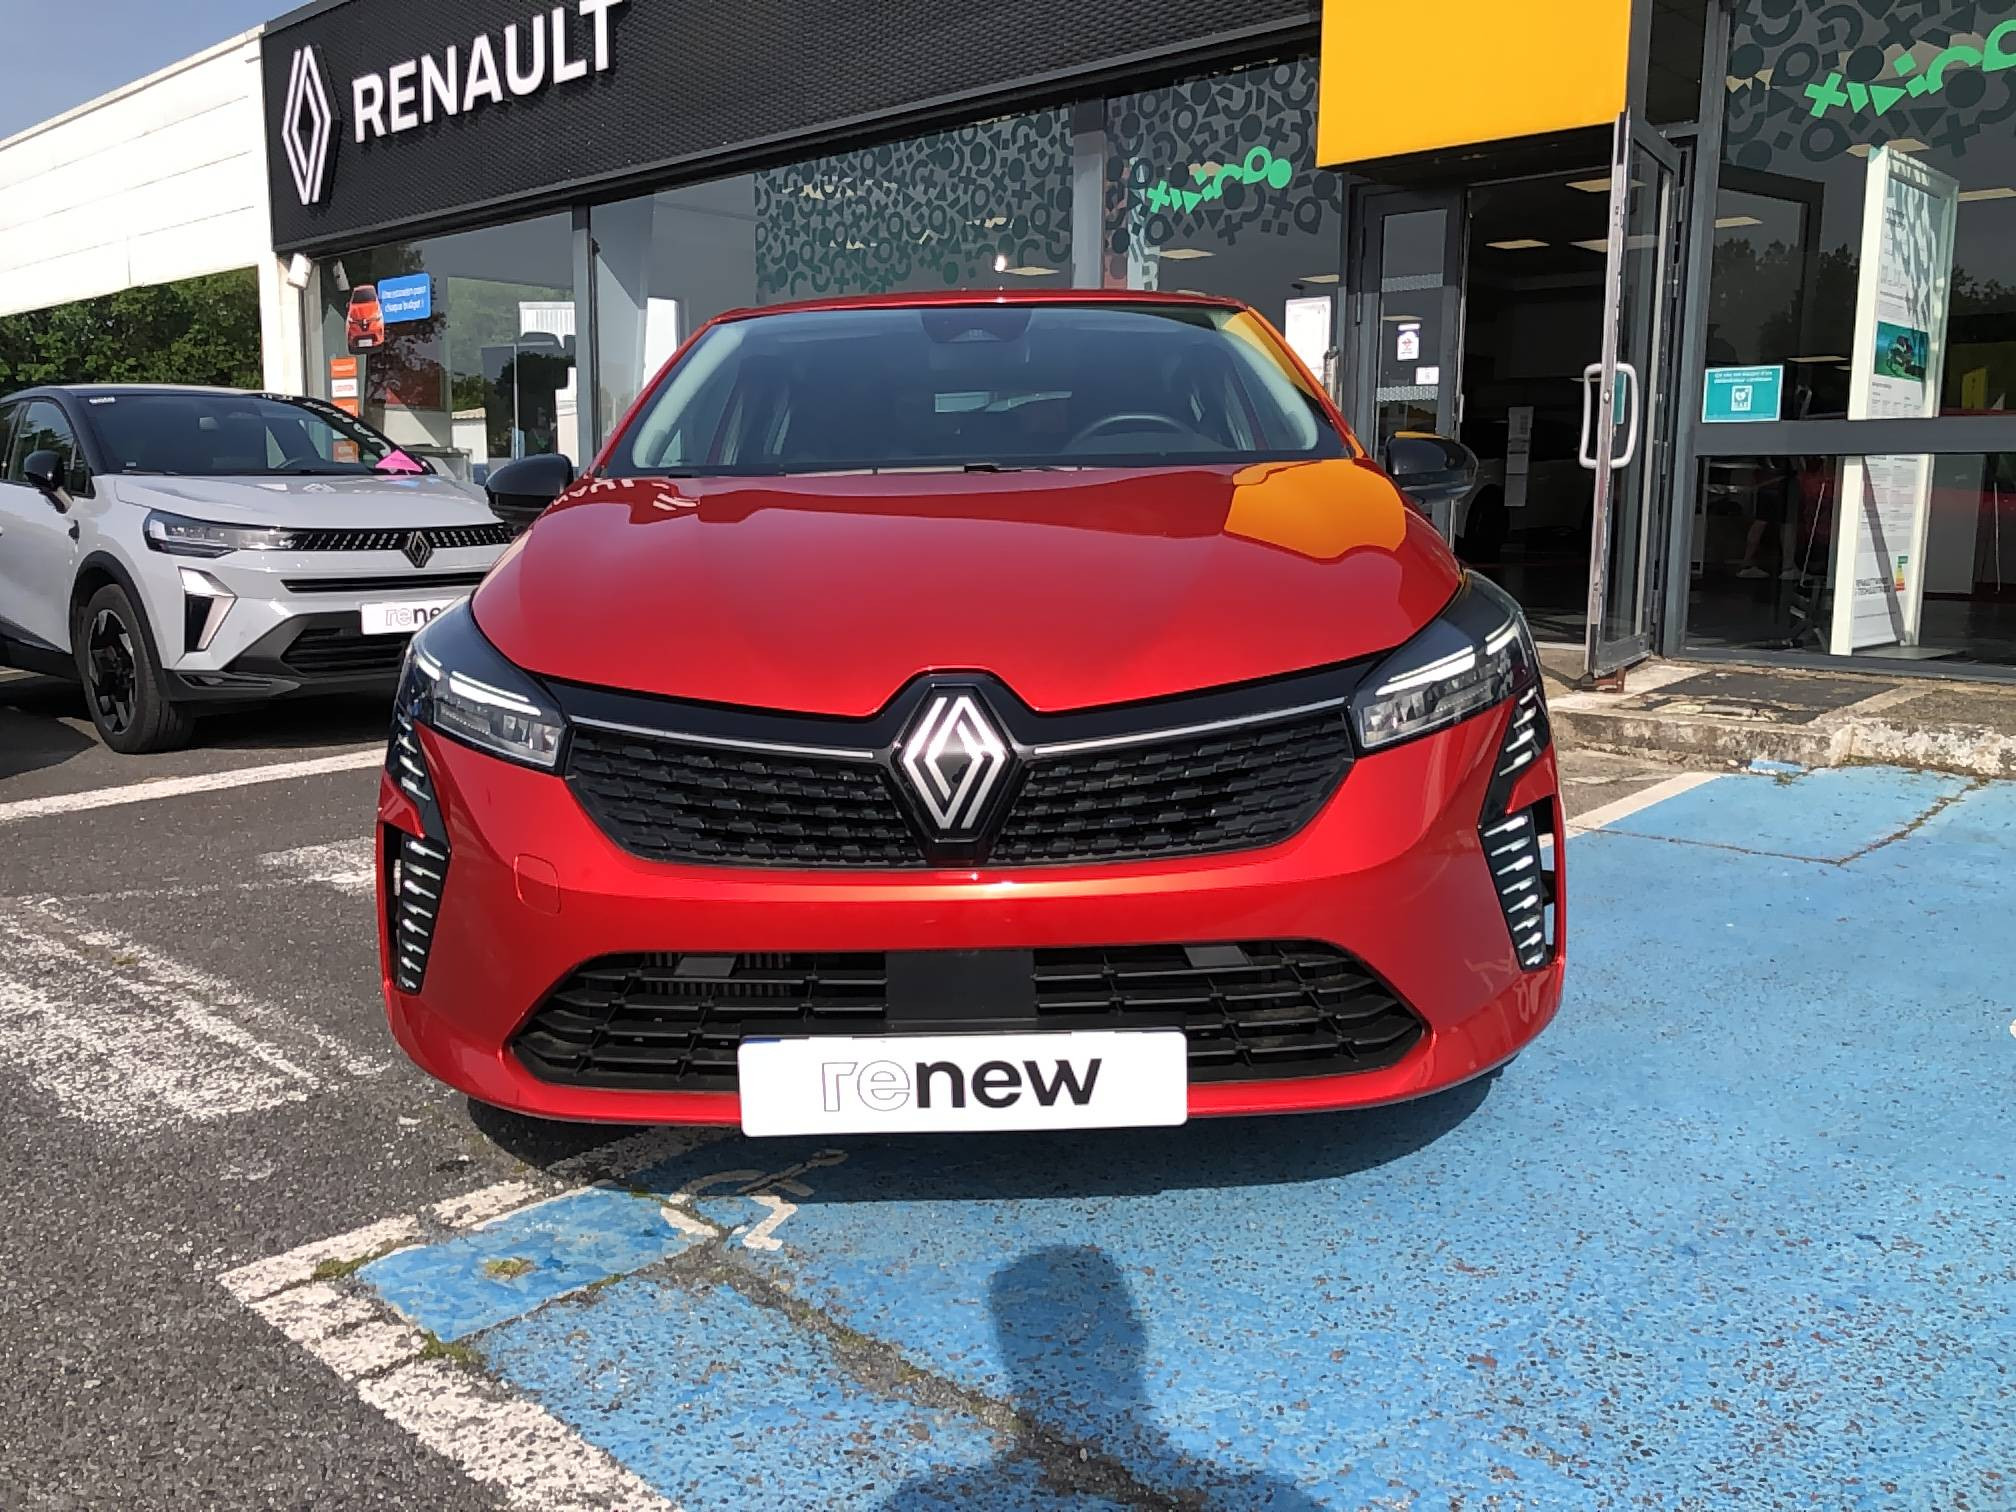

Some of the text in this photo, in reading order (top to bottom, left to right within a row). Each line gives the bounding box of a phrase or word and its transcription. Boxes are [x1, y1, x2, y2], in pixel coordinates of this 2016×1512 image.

[352, 0, 623, 143] RENAULT
[385, 607, 441, 626] rene
[822, 1058, 1102, 1112] renew
